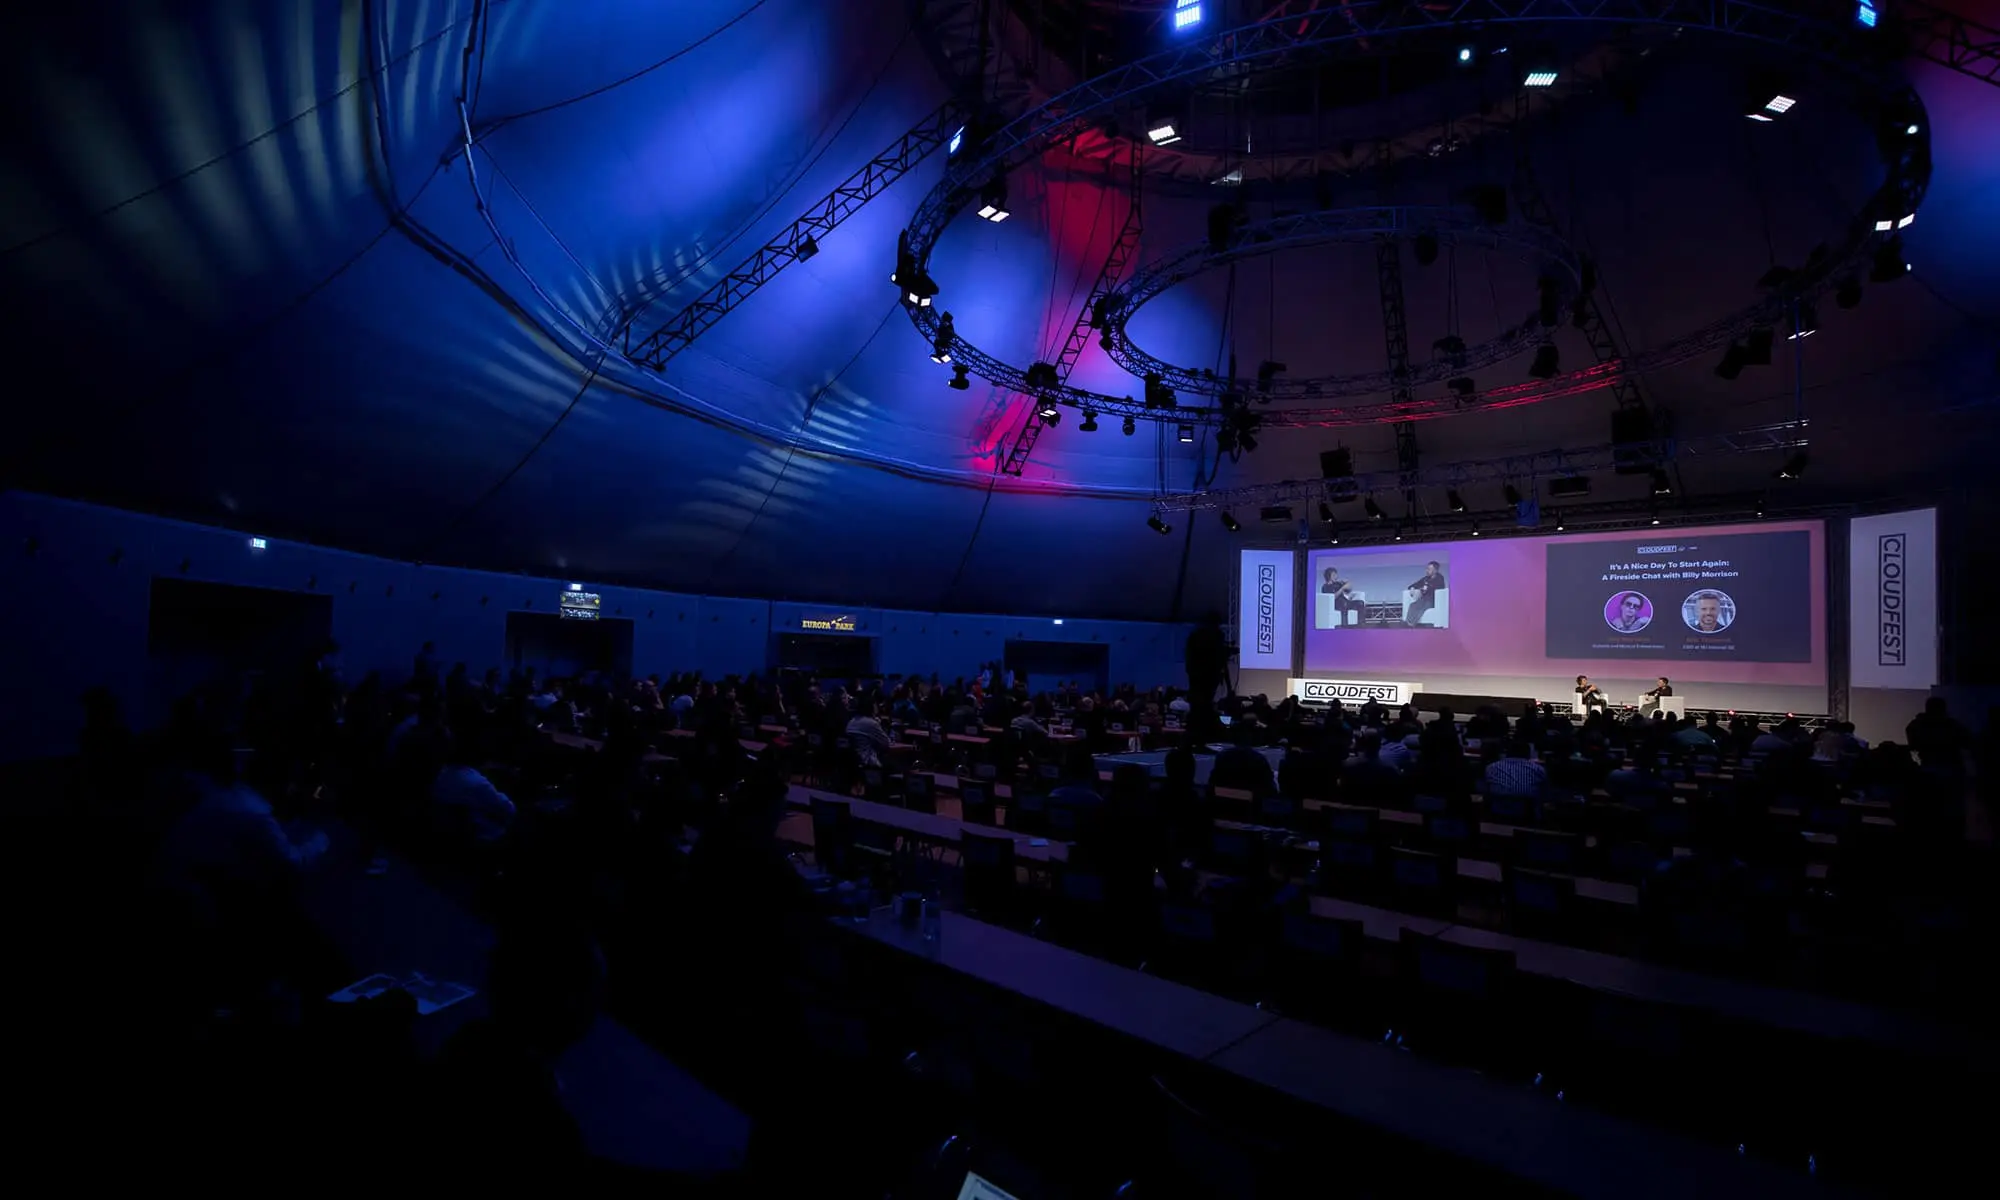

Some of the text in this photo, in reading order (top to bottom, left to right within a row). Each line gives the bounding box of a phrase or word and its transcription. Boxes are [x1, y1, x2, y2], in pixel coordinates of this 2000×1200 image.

[1610, 563, 1622, 571] It's
[1631, 562, 1649, 570] Nice
[1650, 562, 1666, 571] Day
[1668, 561, 1678, 569] To
[1701, 560, 1730, 568] Again:
[1610, 573, 1640, 581] Fireside
[1642, 572, 1661, 580] Chat
[1682, 571, 1700, 579] Billy
[1701, 570, 1739, 578] Morrison
[1883, 538, 1902, 662] CLOUDFEST
[1261, 567, 1273, 651] CLOUDFEST
[802, 620, 855, 631] EUROPA PARK
[1307, 685, 1395, 700] CLOUDFEST
